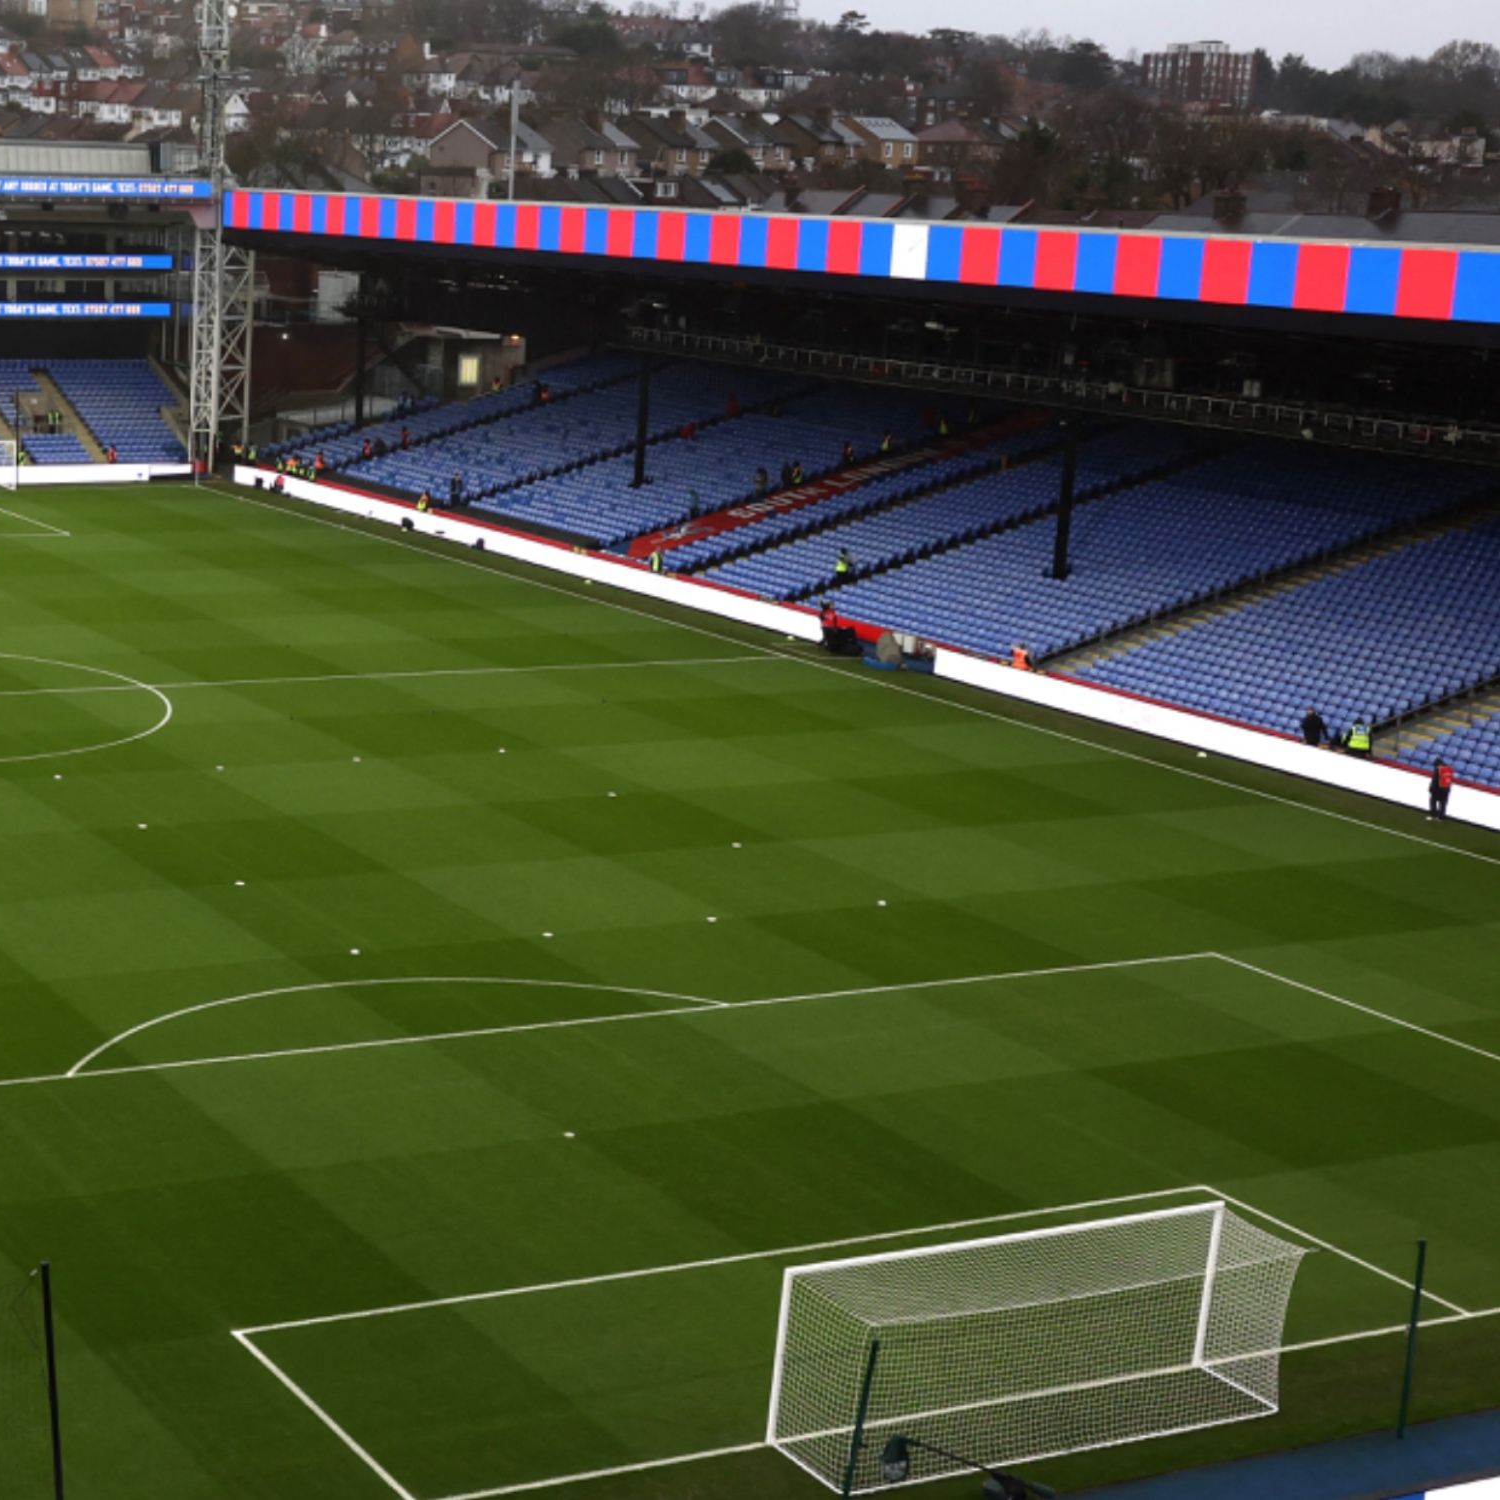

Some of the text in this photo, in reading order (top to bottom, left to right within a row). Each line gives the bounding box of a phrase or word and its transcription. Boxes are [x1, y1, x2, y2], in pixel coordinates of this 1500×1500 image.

[2, 181, 20, 191] ANY
[20, 182, 48, 191] ISSUES
[48, 182, 59, 192] AT
[727, 487, 828, 518] SOUTH
